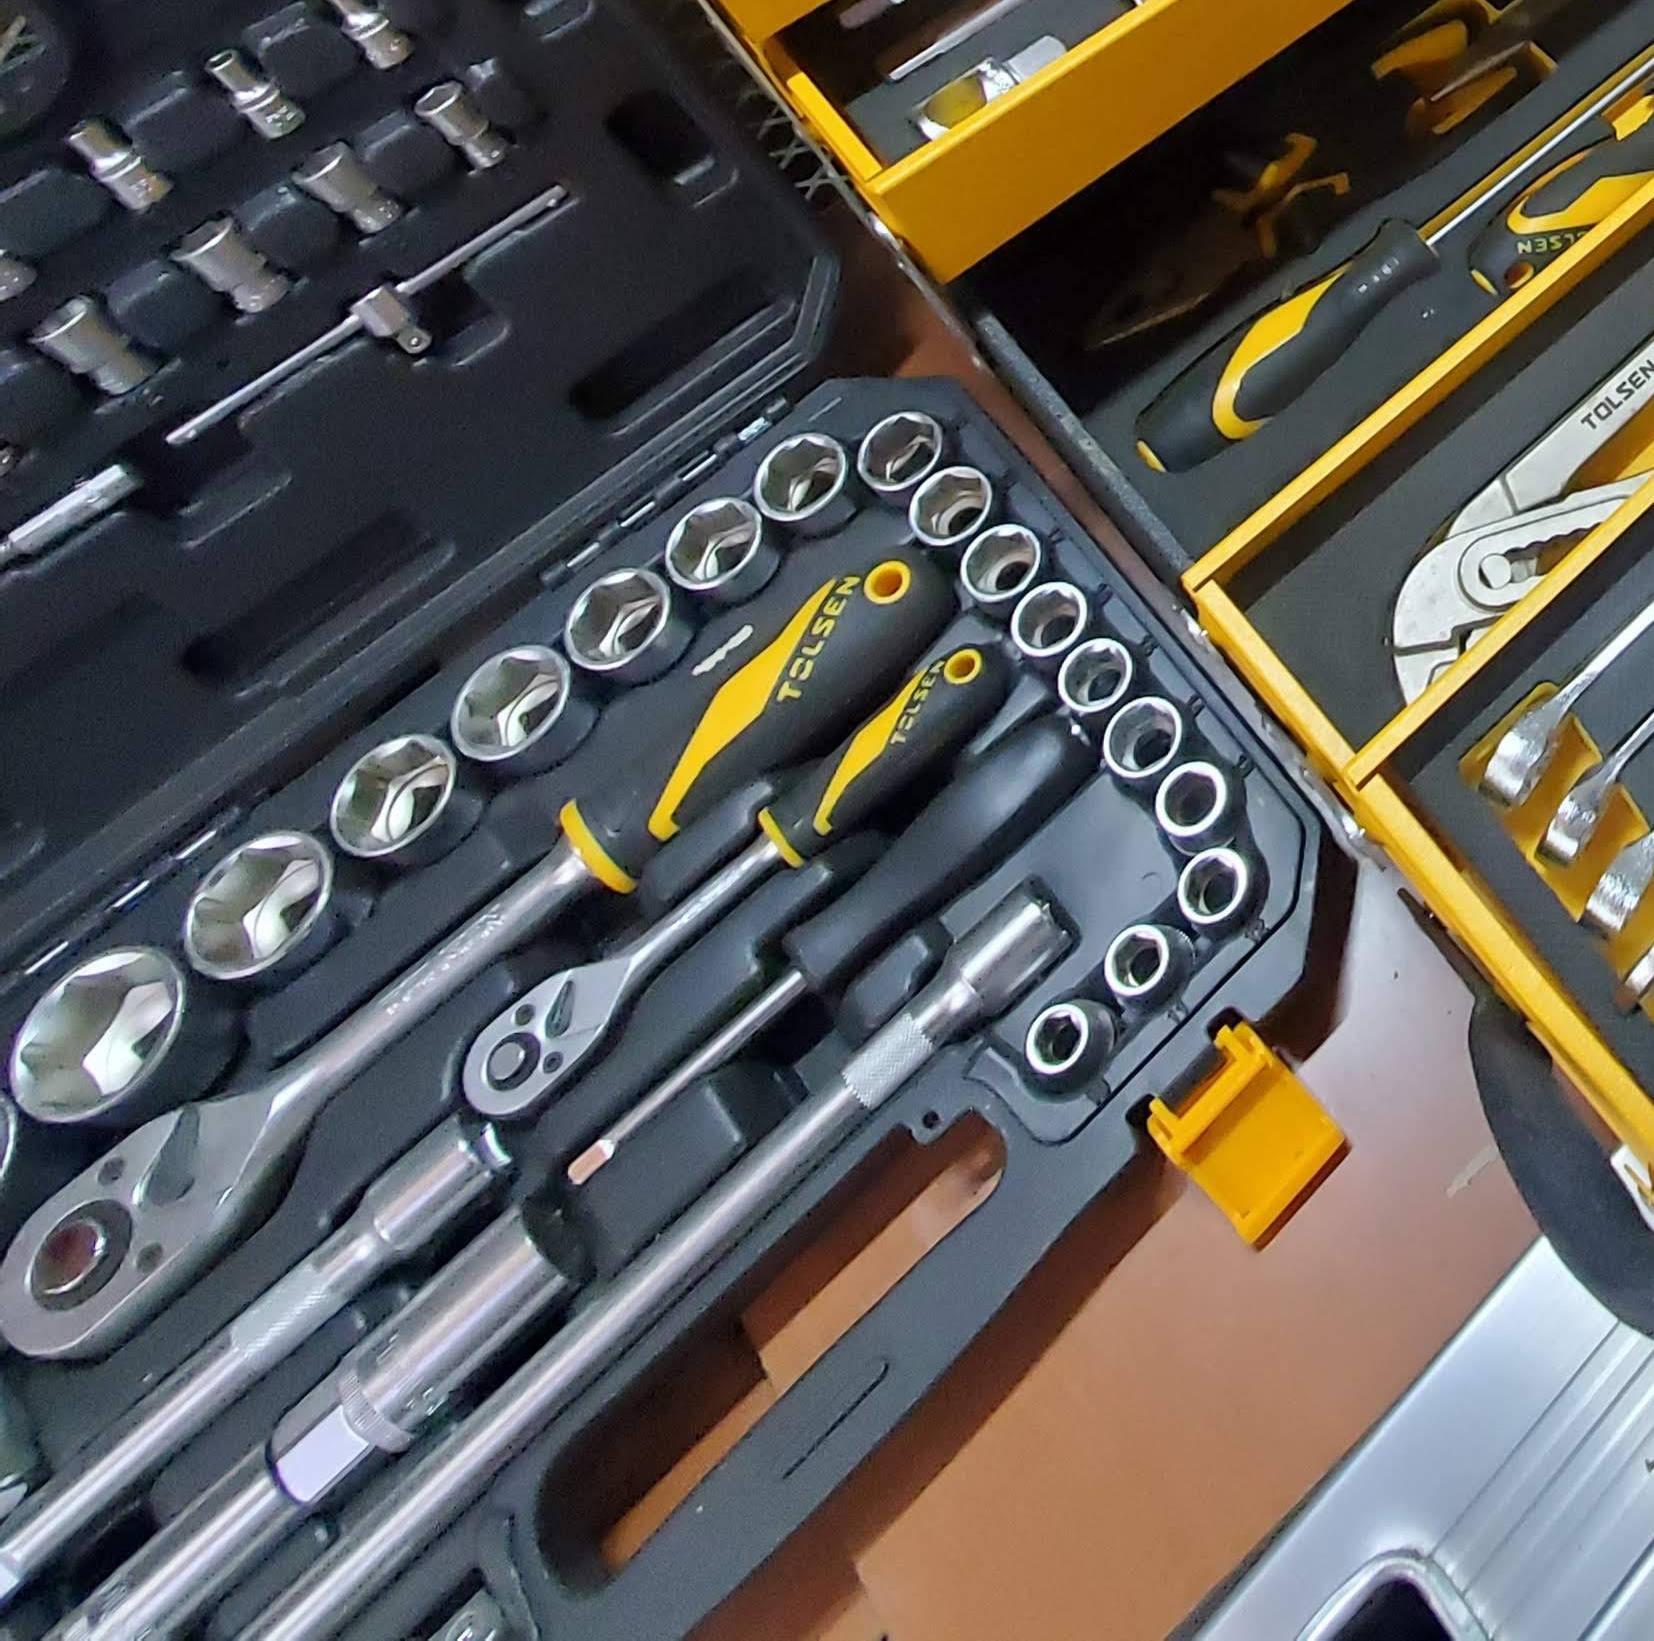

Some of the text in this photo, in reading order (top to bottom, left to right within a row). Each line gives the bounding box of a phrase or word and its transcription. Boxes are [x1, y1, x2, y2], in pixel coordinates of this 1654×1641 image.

[1516, 230, 1587, 255] LSEN
[776, 575, 861, 703] TOLSEN
[889, 659, 947, 746] TOLSEN
